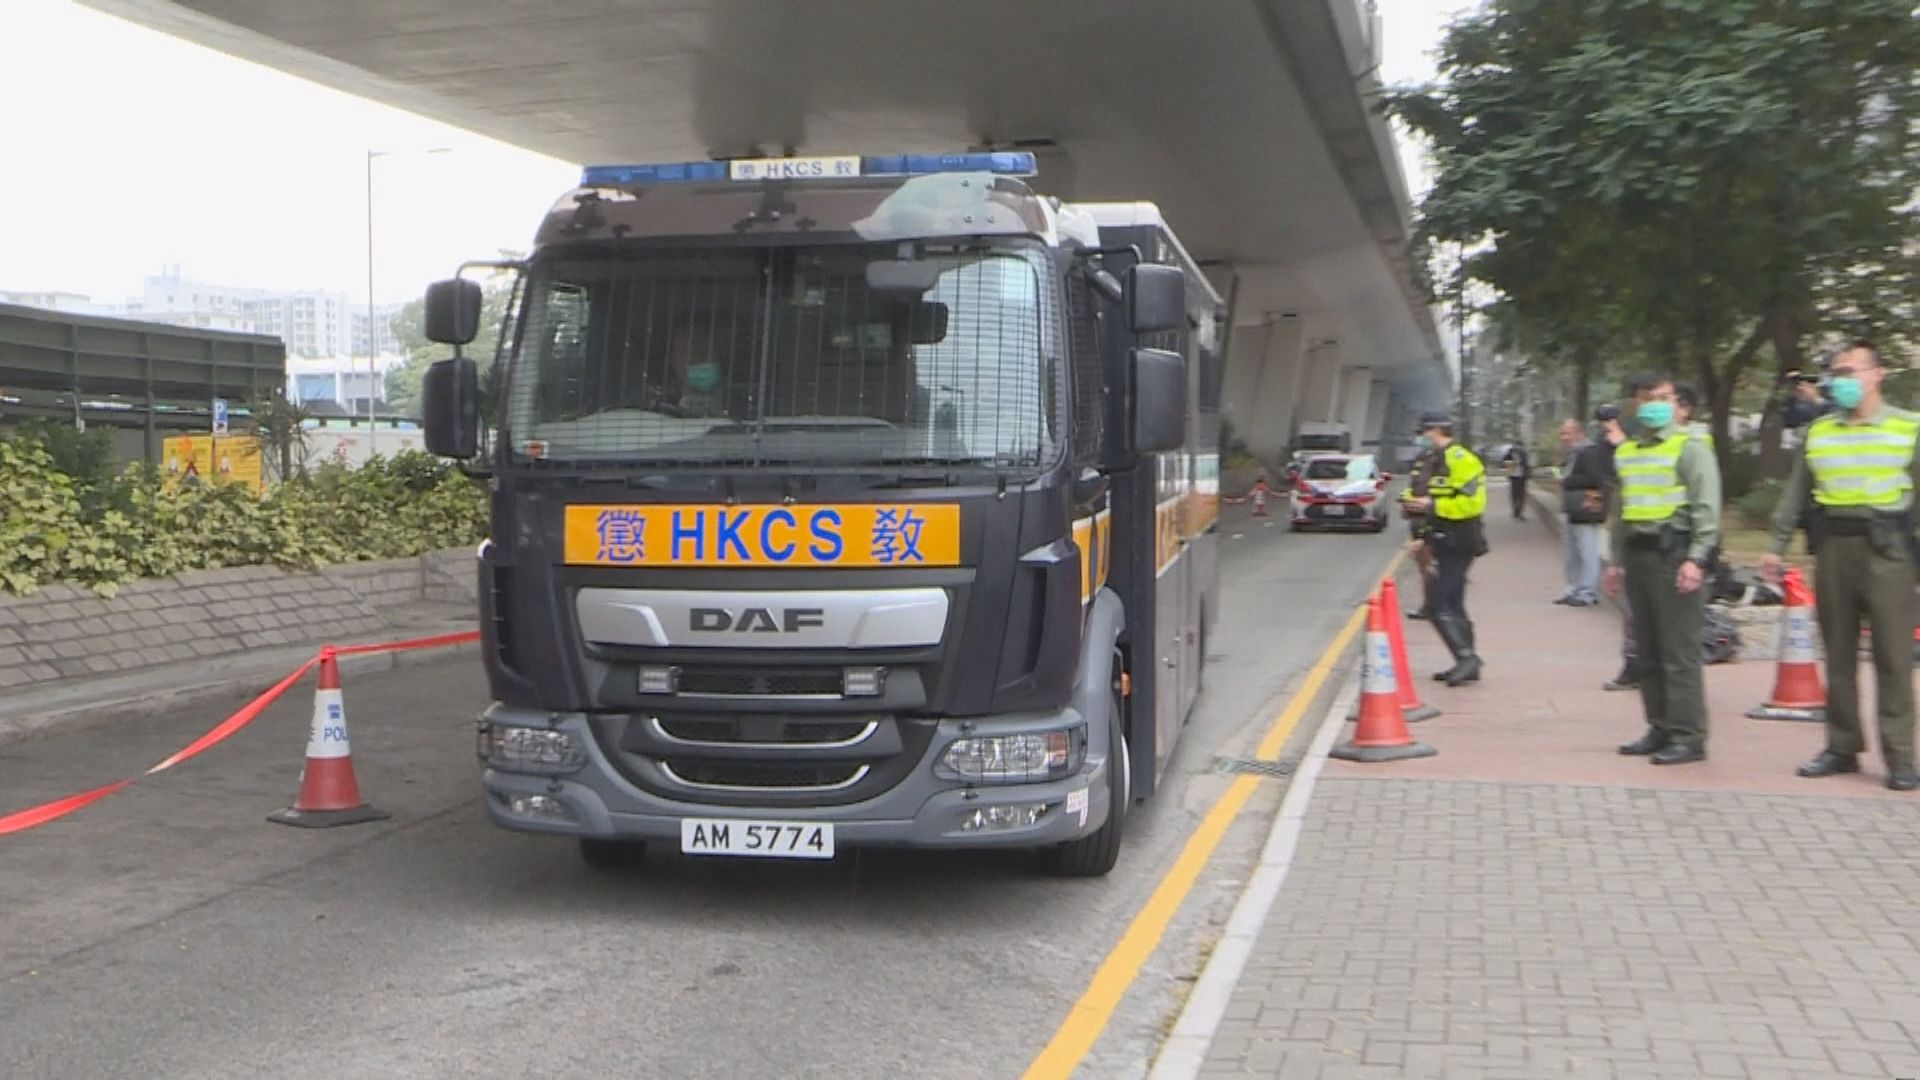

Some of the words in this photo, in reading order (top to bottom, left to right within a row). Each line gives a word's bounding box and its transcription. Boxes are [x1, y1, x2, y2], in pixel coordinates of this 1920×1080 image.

[766, 161, 823, 177] HKCS
[596, 509, 645, 562] 懲
[671, 509, 843, 562] HKCS
[689, 607, 824, 632] DAF
[692, 823, 730, 849] AM
[745, 826, 824, 852] 5774
